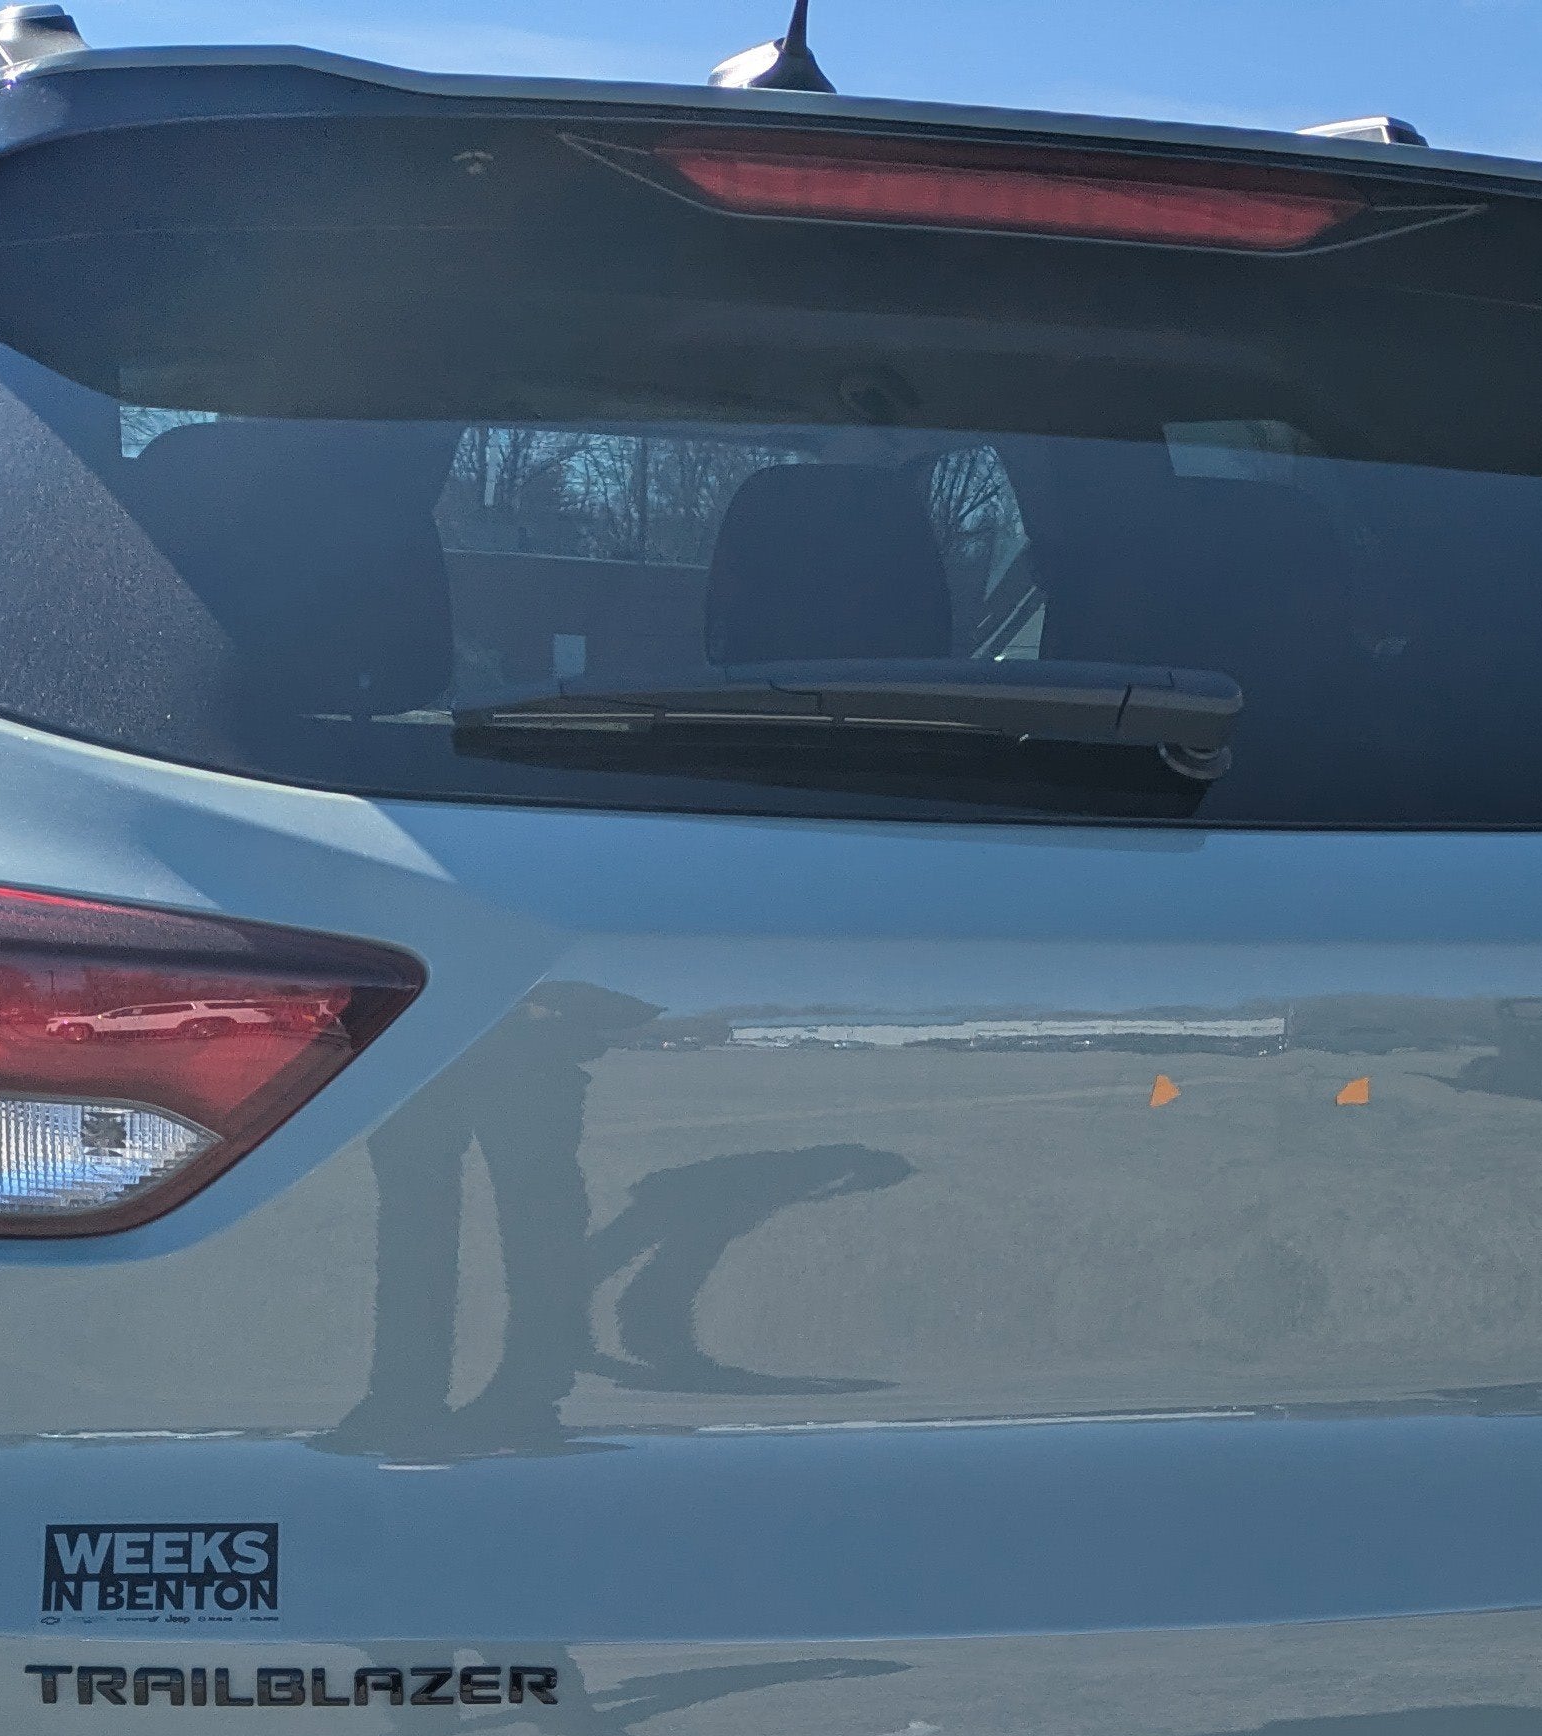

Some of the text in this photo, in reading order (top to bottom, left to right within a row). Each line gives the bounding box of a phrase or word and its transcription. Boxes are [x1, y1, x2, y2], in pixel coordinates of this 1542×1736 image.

[53, 1530, 269, 1575] WEEKS
[42, 1580, 279, 1612] IN BENTON
[165, 1614, 190, 1624] Jeep
[24, 1664, 561, 1707] TRAILBLAZER
